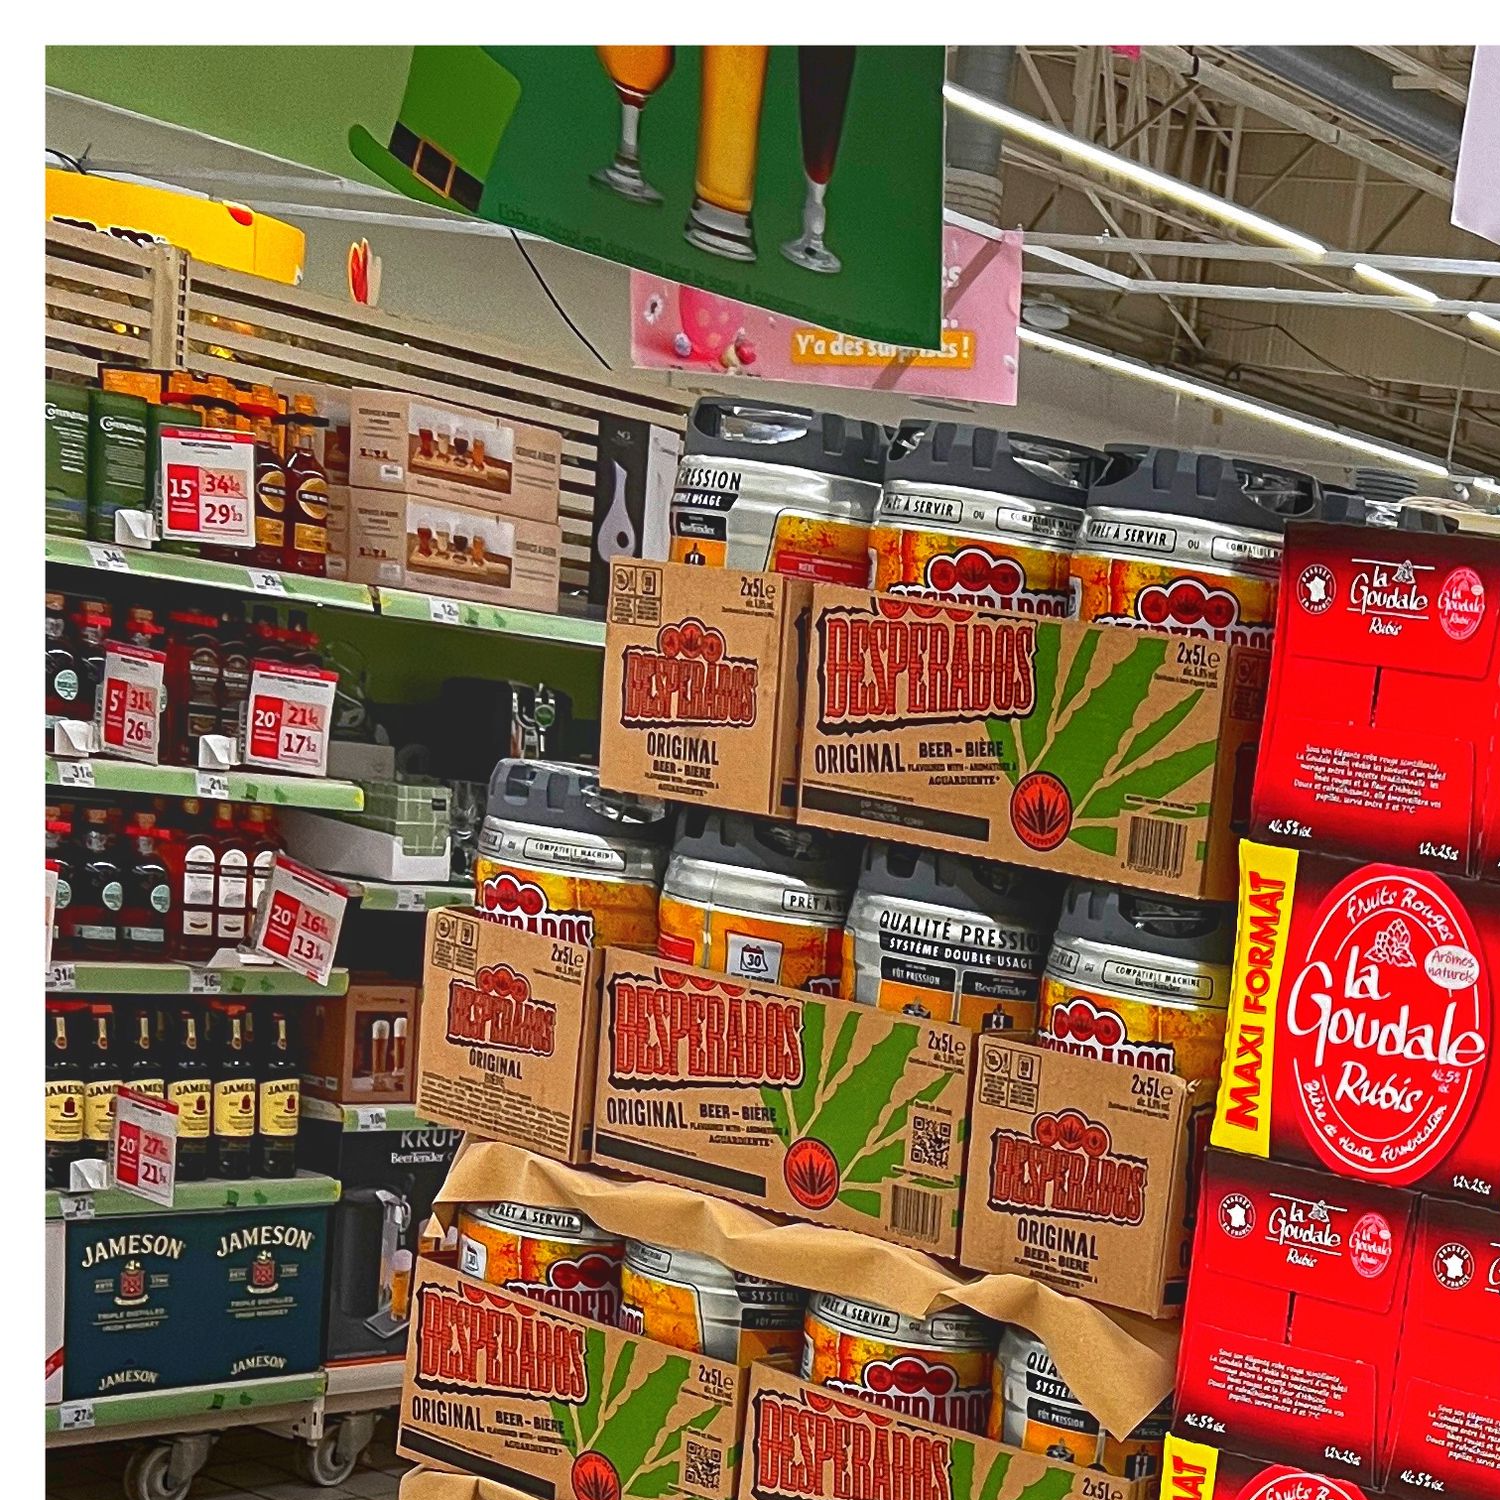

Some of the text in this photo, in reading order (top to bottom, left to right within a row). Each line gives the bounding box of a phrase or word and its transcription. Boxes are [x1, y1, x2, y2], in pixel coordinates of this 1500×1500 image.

[830, 334, 863, 355] des
[913, 500, 955, 519] SERVIR
[1124, 528, 1168, 547] SERVIR
[1350, 574, 1429, 611] Goudale
[1373, 565, 1389, 589] la
[825, 617, 1037, 720] DESPERADOS
[625, 652, 757, 728] DESPERADOS
[647, 732, 719, 766] ORIGINAL
[815, 742, 905, 774] ORIGINAL
[919, 737, 1003, 758] BEER BIÈRE
[653, 760, 677, 774] BEER
[879, 909, 1041, 952] QUALITÉ PRESSIO
[1346, 888, 1456, 942] Fruits Rouges
[889, 936, 1033, 970] SYSTÈME DOUBLE USAGE
[1431, 949, 1476, 969] Arômes
[1342, 946, 1391, 1000] la
[1427, 964, 1477, 984] naturels
[1225, 870, 1287, 1131] MAXI FORMAT
[1287, 961, 1486, 1068] Goudale
[614, 983, 803, 1083] DESPERADOS
[1335, 1061, 1420, 1114] Rubis
[607, 1097, 689, 1129] ORIGINAL
[700, 1104, 730, 1120] BEER
[401, 1130, 461, 1149] KRUP
[995, 1134, 1146, 1222] DESPERADOS
[533, 1209, 575, 1229] SERVIR
[82, 1235, 186, 1268] JAMESON
[216, 1225, 315, 1257] JAMESON
[1017, 1217, 1098, 1261] ORIGINAL
[421, 1288, 586, 1402] DESPERADOS
[99, 1369, 160, 1391] JAMESON
[230, 1355, 287, 1376] JAMESON
[412, 1397, 485, 1431] ORIGINAL
